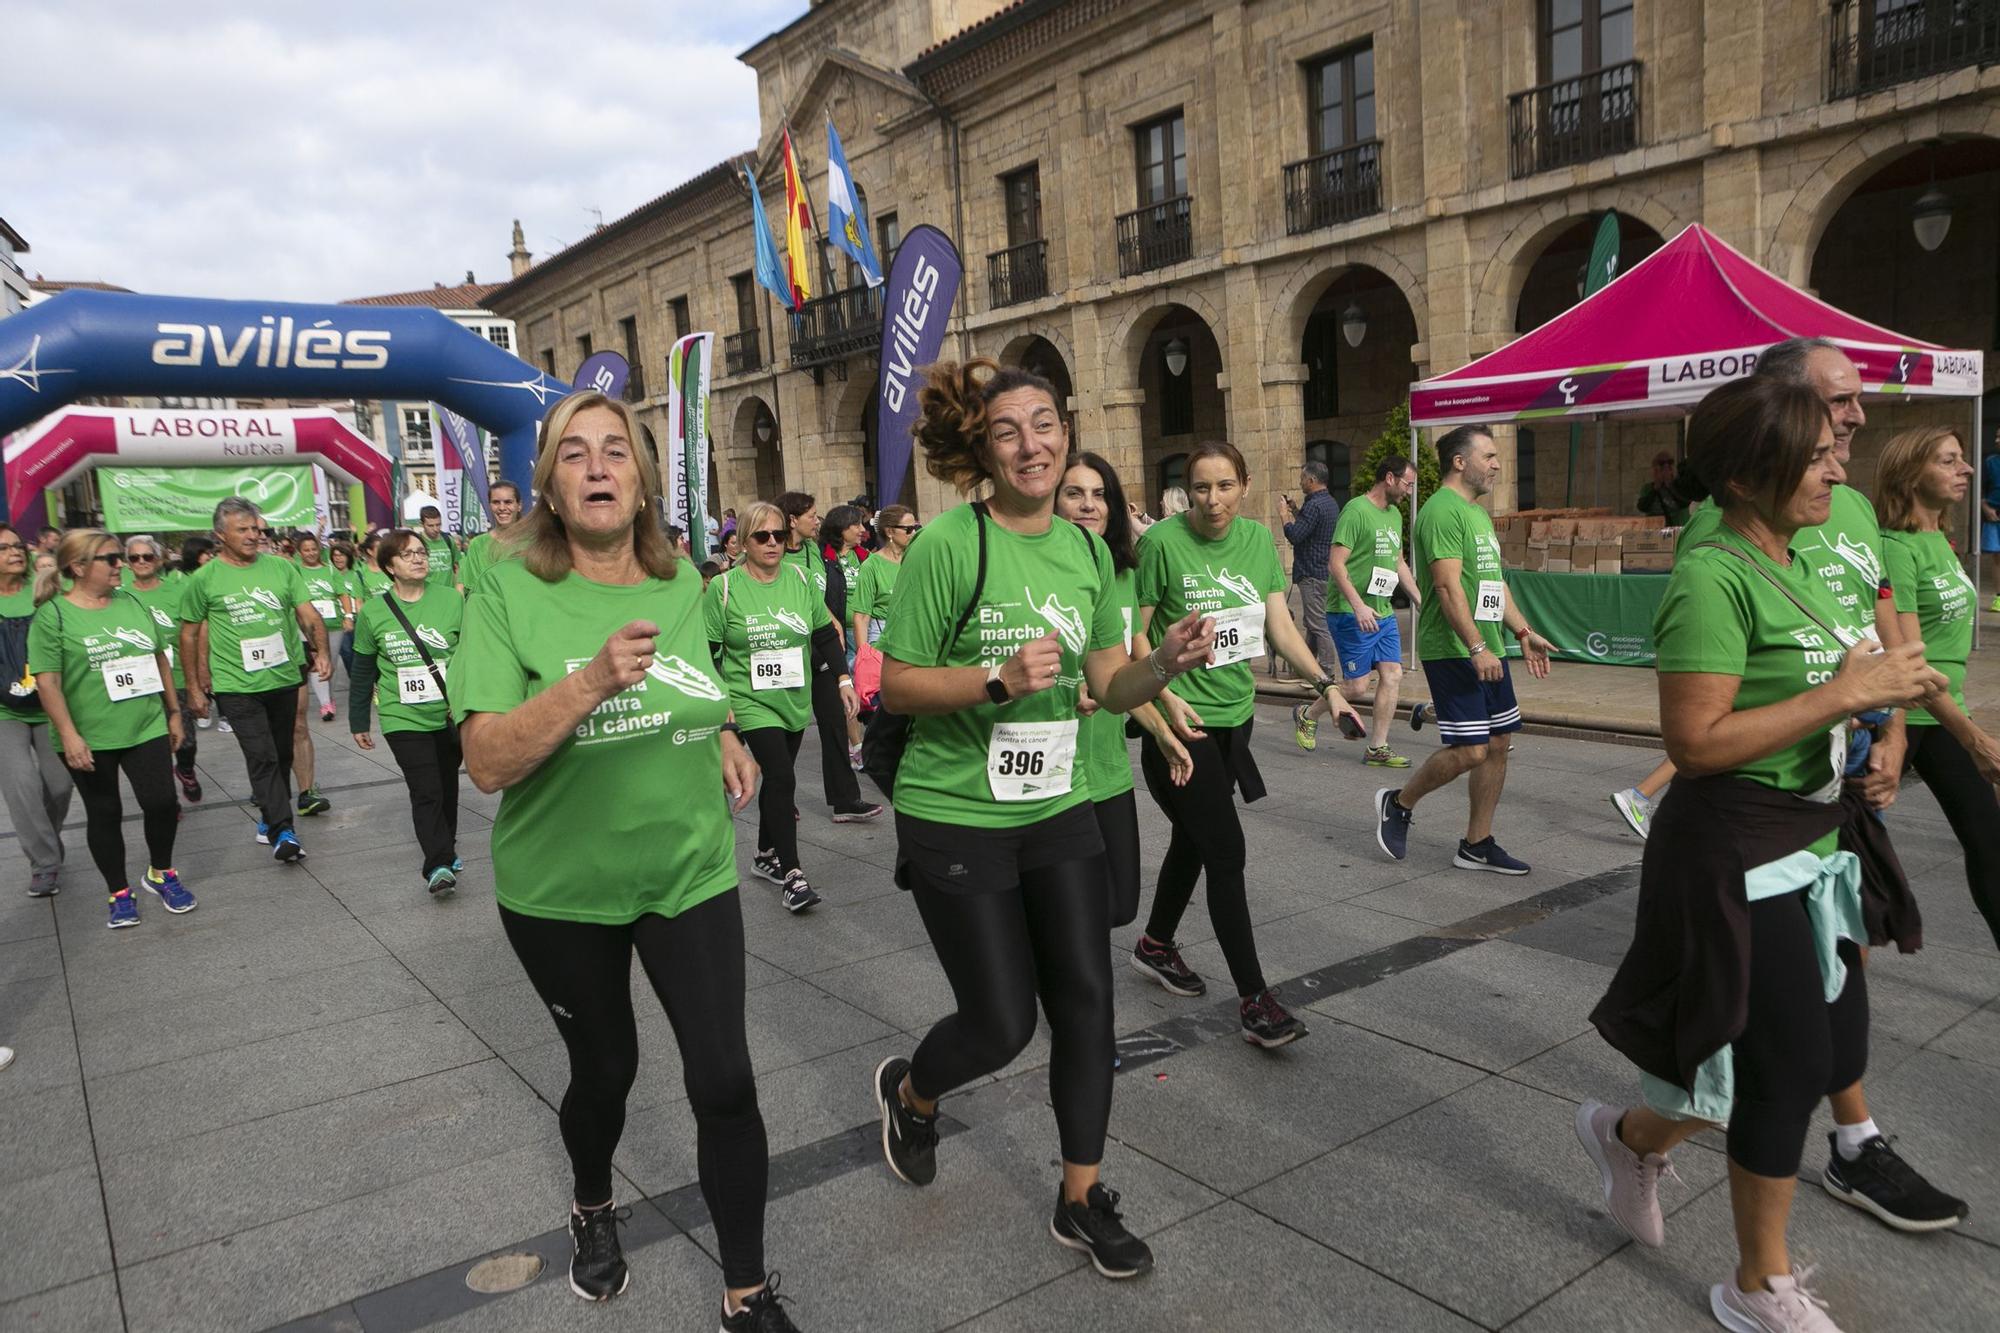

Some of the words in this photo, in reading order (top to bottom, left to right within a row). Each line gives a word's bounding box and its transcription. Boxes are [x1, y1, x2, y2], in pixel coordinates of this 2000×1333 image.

[883, 254, 940, 414] avilés
[151, 314, 392, 369] avilés
[1662, 353, 1757, 383] LABOR
[1937, 355, 1978, 376] LABORAL
[128, 416, 282, 438] LABORAL
[223, 441, 284, 457] kutxa
[444, 477, 462, 533] BORAL
[1818, 562, 1846, 578] rcha
[1183, 577, 1198, 588] En
[1375, 577, 1387, 588] 412
[1934, 578, 1950, 590] En
[223, 596, 237, 604] En
[1184, 588, 1225, 599] marcha
[1185, 600, 1222, 611] contra
[746, 616, 758, 625] En
[979, 608, 1004, 624] En
[747, 623, 780, 633] marcha
[980, 624, 1045, 641] marcha
[83, 637, 99, 647] En
[747, 632, 777, 641] contra
[1794, 632, 1824, 648] En
[87, 641, 123, 654] marcha
[252, 649, 265, 660] 97
[387, 647, 414, 656] contra
[981, 642, 1020, 657] cont
[88, 650, 120, 662] contra
[757, 663, 782, 677] 693
[115, 672, 134, 688] 96
[404, 679, 425, 692] 183
[590, 694, 642, 716] ontra
[575, 718, 595, 738] el
[602, 710, 672, 735] cáncer
[996, 736, 1020, 744] contra
[998, 750, 1044, 776] 396
